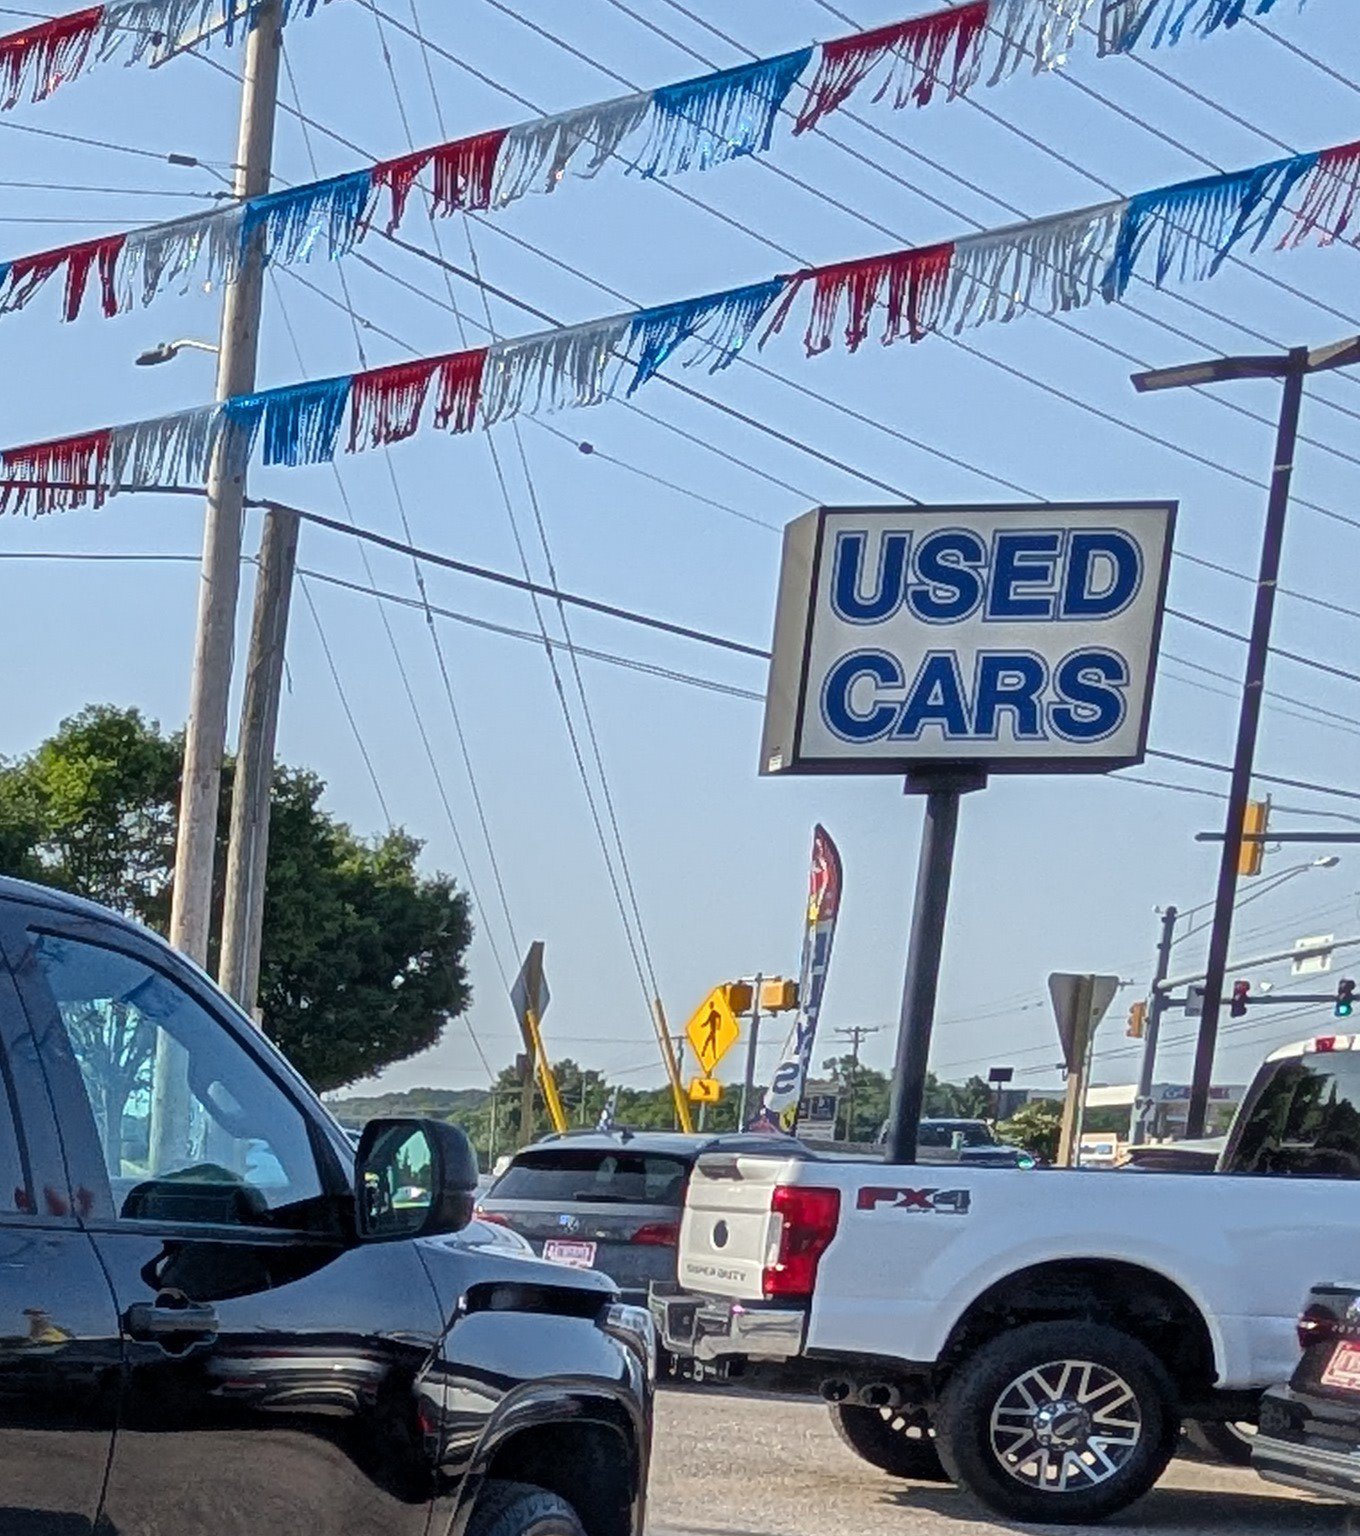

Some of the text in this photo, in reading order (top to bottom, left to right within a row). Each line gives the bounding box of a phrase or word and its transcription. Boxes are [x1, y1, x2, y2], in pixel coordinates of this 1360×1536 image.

[830, 527, 1144, 625] USED
[819, 647, 1131, 743] CARS
[857, 1187, 971, 1211] FX4
